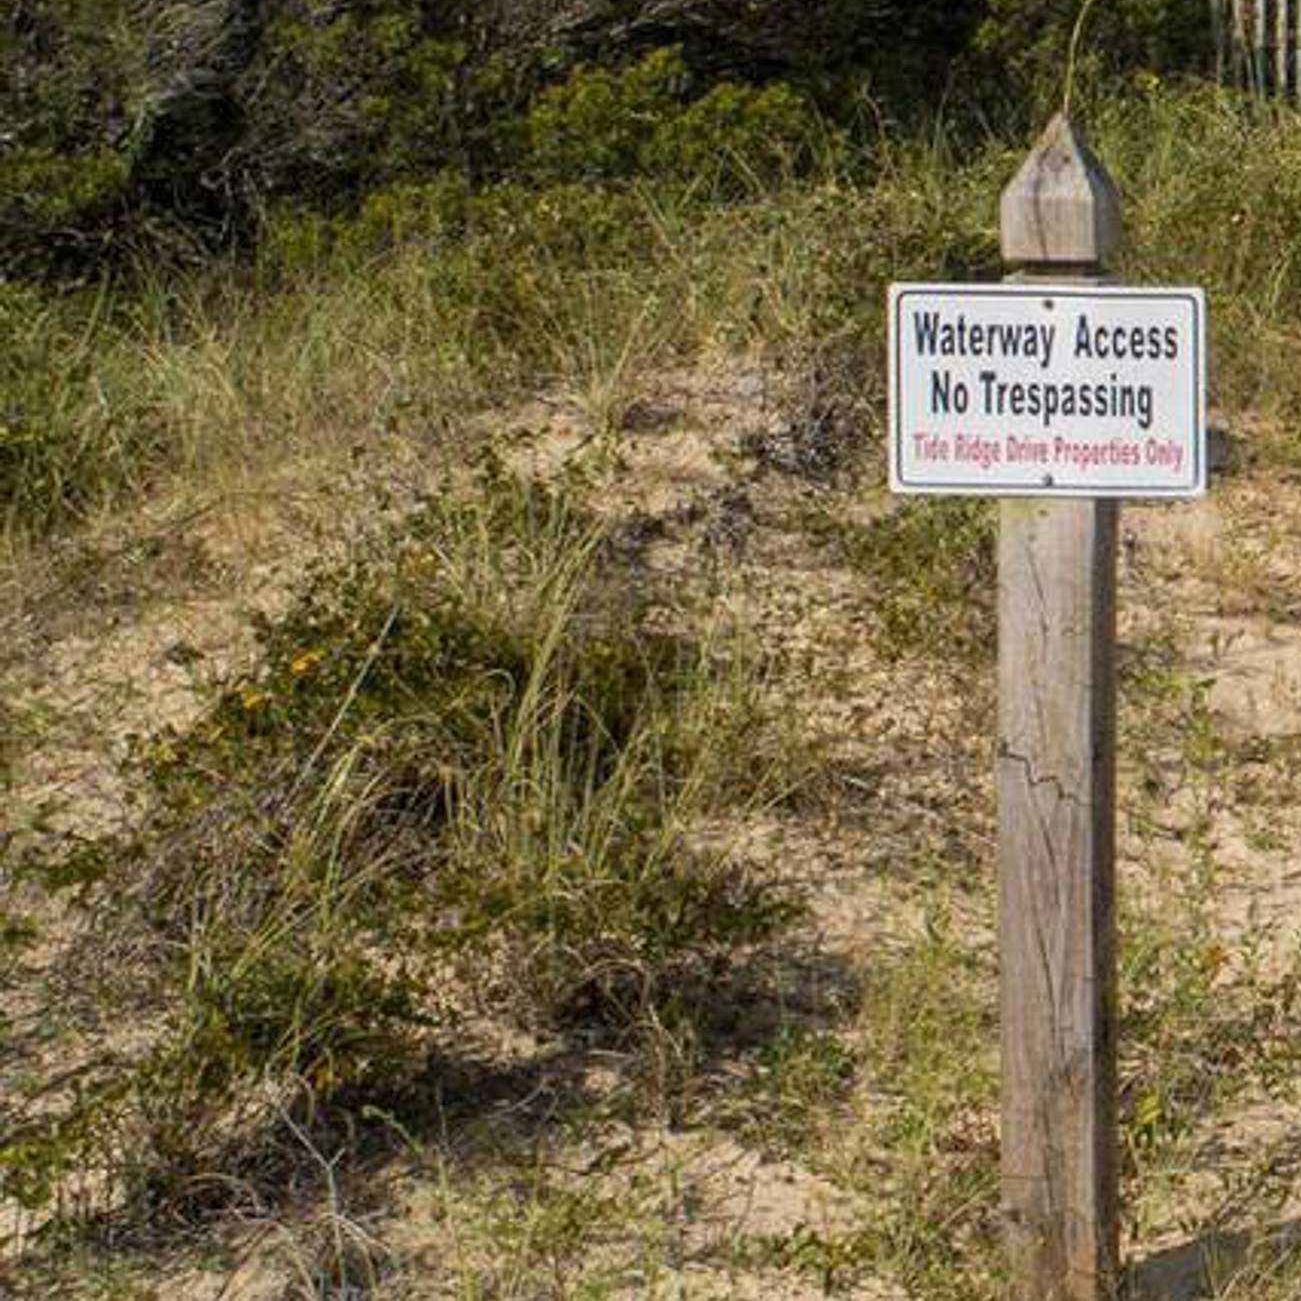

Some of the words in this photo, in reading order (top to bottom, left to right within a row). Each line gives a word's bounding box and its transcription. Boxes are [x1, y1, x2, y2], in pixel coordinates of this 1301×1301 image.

[914, 311, 1055, 367] Waterway
[1075, 315, 1178, 359] Access
[931, 370, 968, 414] No
[980, 372, 1152, 428] Trespassing
[913, 434, 947, 461] Tide
[955, 434, 1001, 468] Ridge
[1007, 436, 1048, 463] Drive
[1055, 438, 1140, 470] Properties
[1147, 440, 1183, 471] Only
